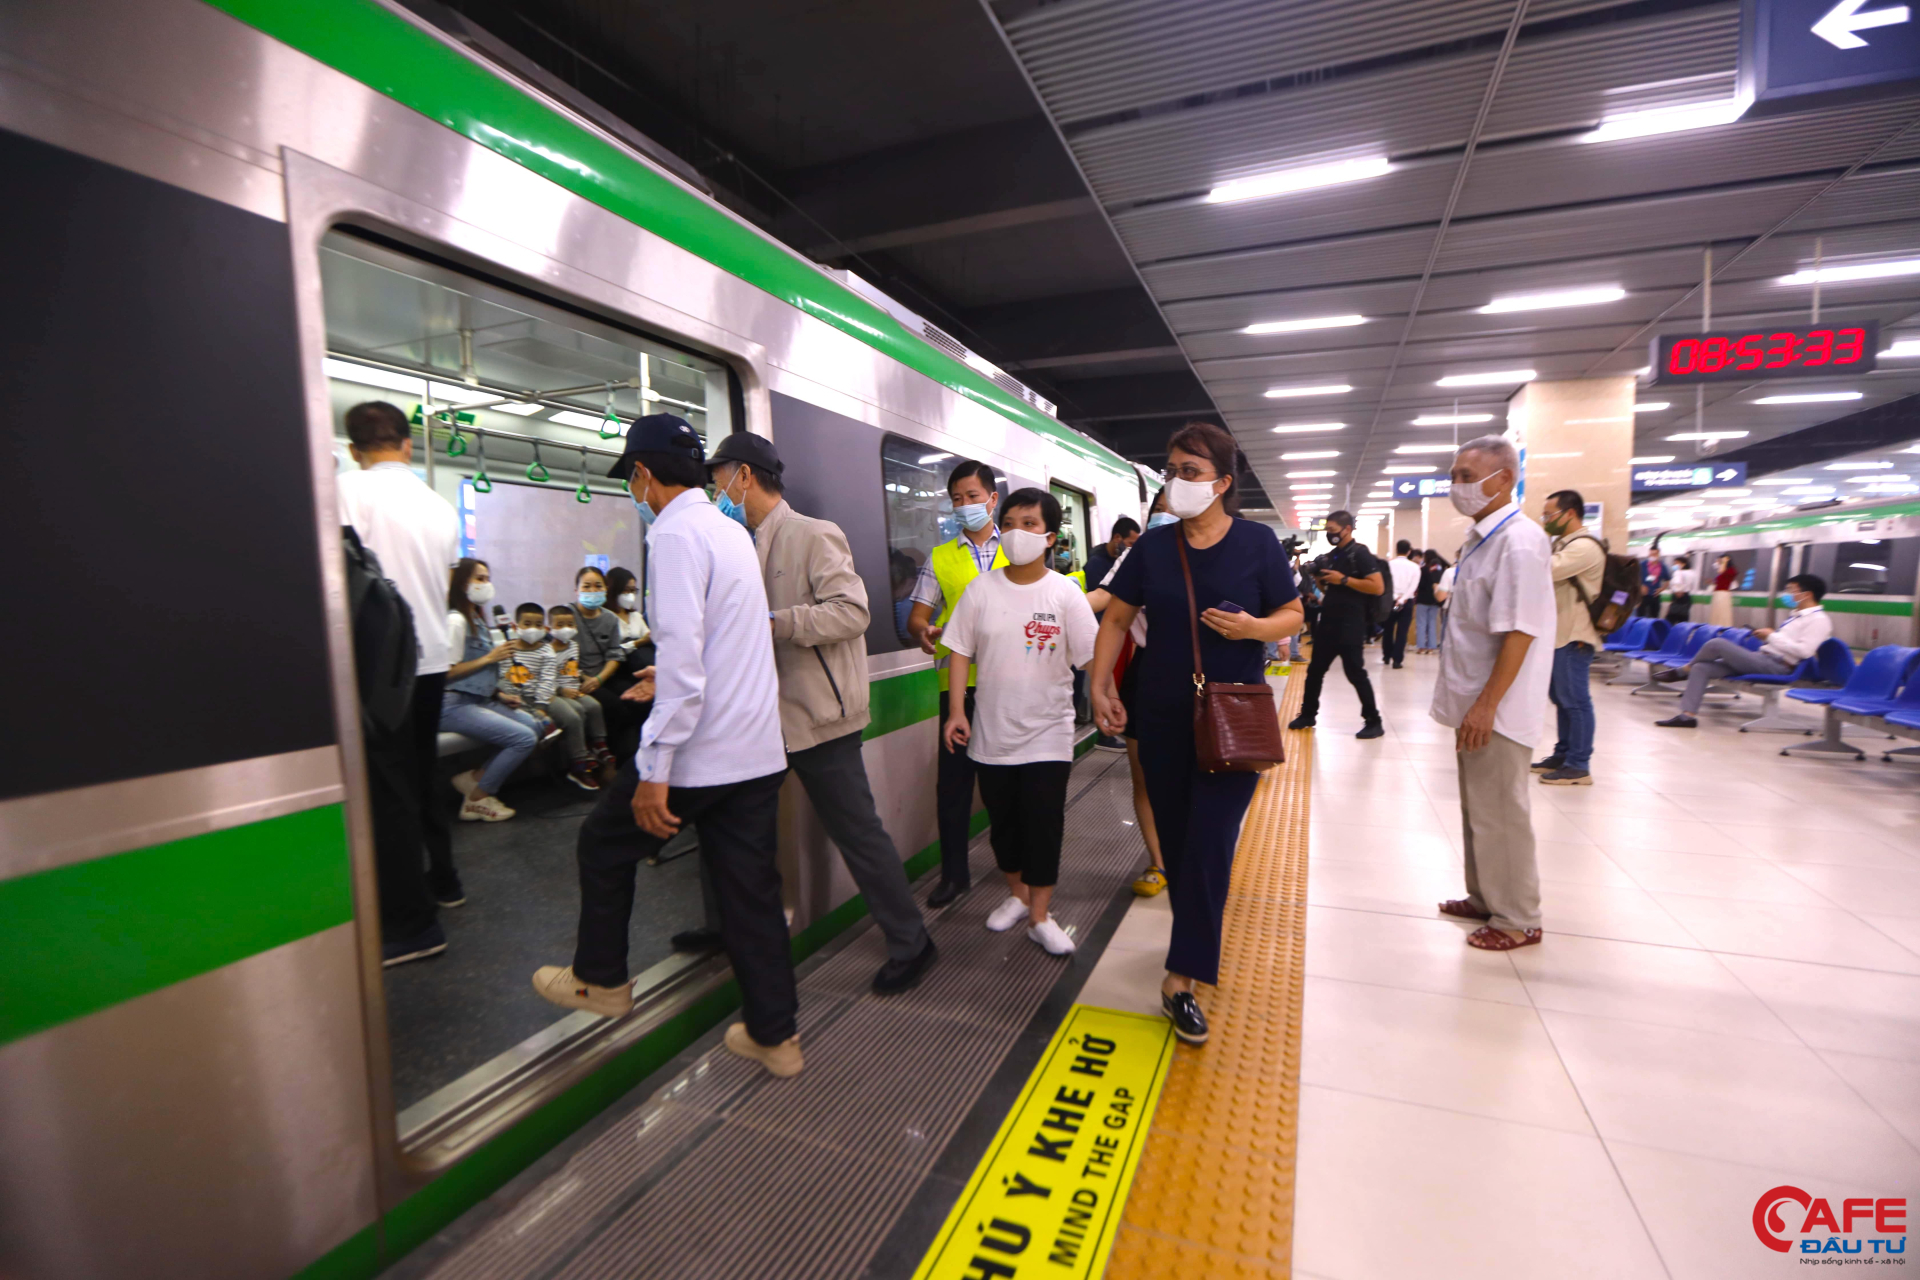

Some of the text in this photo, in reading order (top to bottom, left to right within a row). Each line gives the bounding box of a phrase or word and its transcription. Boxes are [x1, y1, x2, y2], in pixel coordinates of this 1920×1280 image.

[1669, 327, 1866, 375] 08:53:33
[1023, 620, 1061, 641] Chups
[961, 1033, 1117, 1280] HÚ Ý KHE HỞ
[1048, 1087, 1135, 1269] MIND THE GAP
